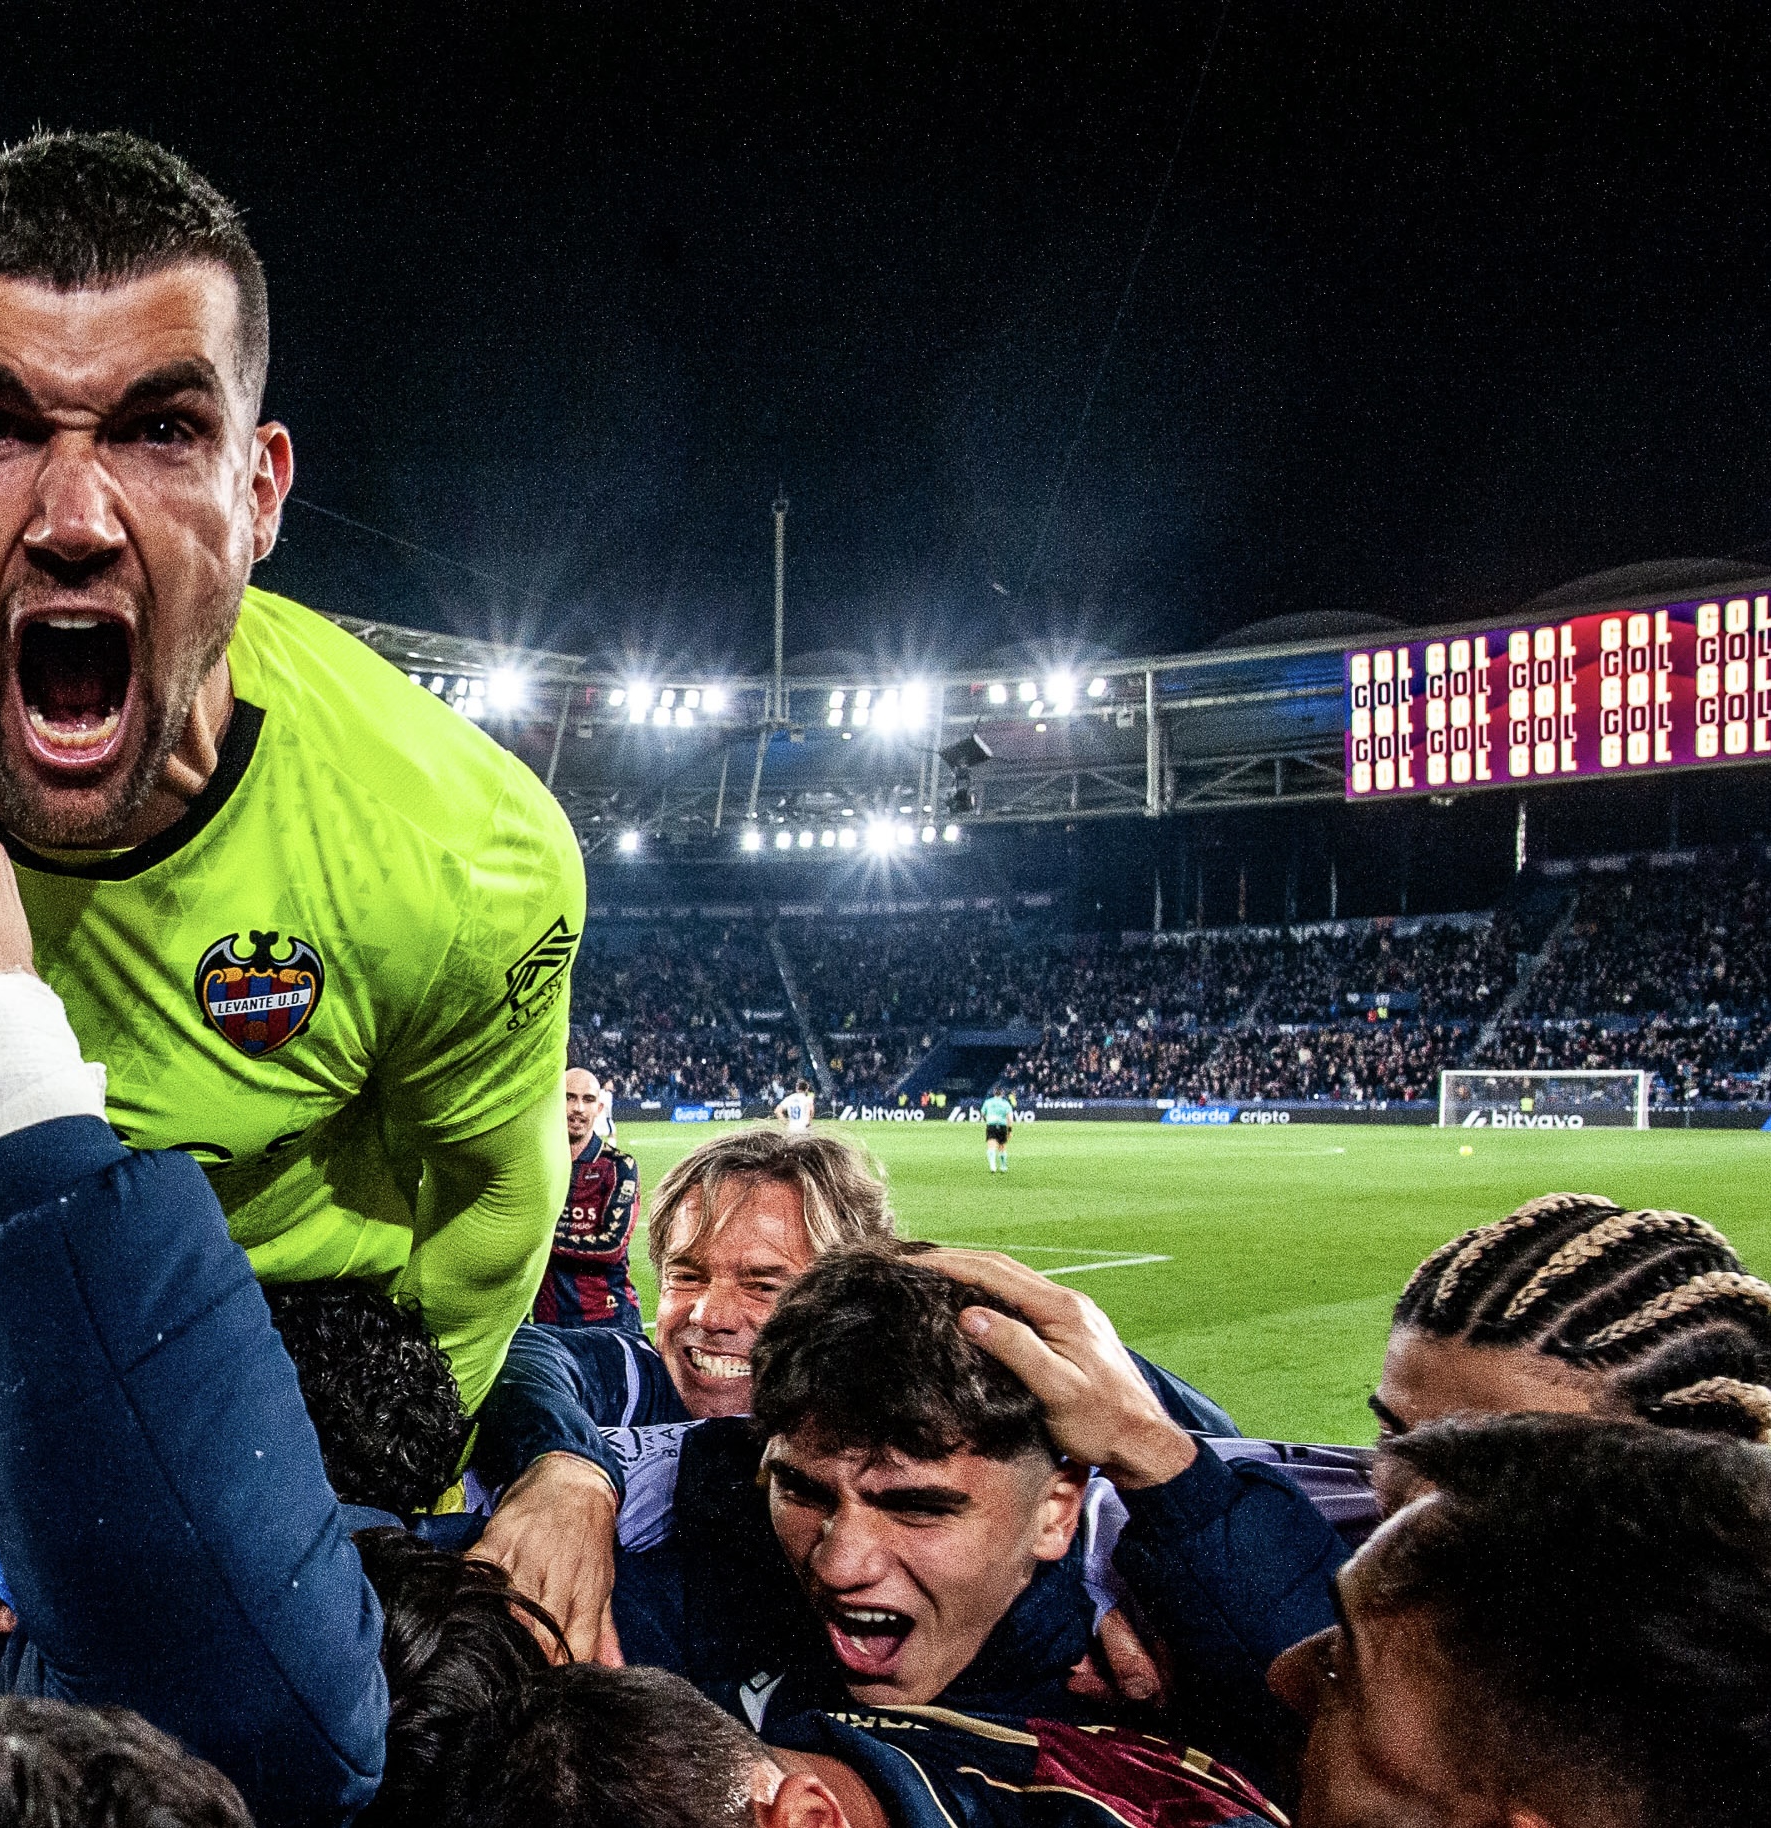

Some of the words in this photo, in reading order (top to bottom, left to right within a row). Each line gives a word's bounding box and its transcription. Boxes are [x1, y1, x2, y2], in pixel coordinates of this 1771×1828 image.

[1351, 648, 1413, 685] GOL
[1426, 637, 1491, 675] GOL
[1509, 624, 1576, 663] GOL
[1600, 610, 1672, 651] GOL
[1696, 595, 1771, 638] GOL
[1351, 679, 1413, 710] GOL
[1426, 667, 1491, 700] GOL
[1509, 657, 1576, 690] GOL
[1600, 643, 1672, 679] GOL
[1696, 629, 1771, 667] GOL
[1351, 704, 1413, 738] GOL
[1426, 693, 1491, 730] GOL
[1509, 683, 1576, 720] GOL
[1600, 671, 1672, 710] GOL
[1696, 658, 1771, 698] GOL
[1351, 733, 1413, 764] GOL
[1426, 724, 1491, 756] GOL
[1509, 715, 1576, 746] GOL
[1600, 703, 1672, 737] GOL
[1696, 690, 1771, 727] GOL
[1351, 757, 1413, 793] GOL
[1426, 750, 1491, 785] GOL
[1509, 740, 1576, 777] GOL
[1600, 730, 1672, 768] GOL
[1696, 719, 1771, 757] GOL
[217, 996, 273, 1014] LEVANTE
[278, 992, 303, 1007] U.D.
[674, 1105, 710, 1122] Guarda
[713, 1107, 741, 1121] cripto
[862, 1106, 925, 1121] bitvavo
[1169, 1108, 1229, 1123] Guarda
[1240, 1109, 1290, 1125] cripto
[1492, 1109, 1584, 1129] bitvavo
